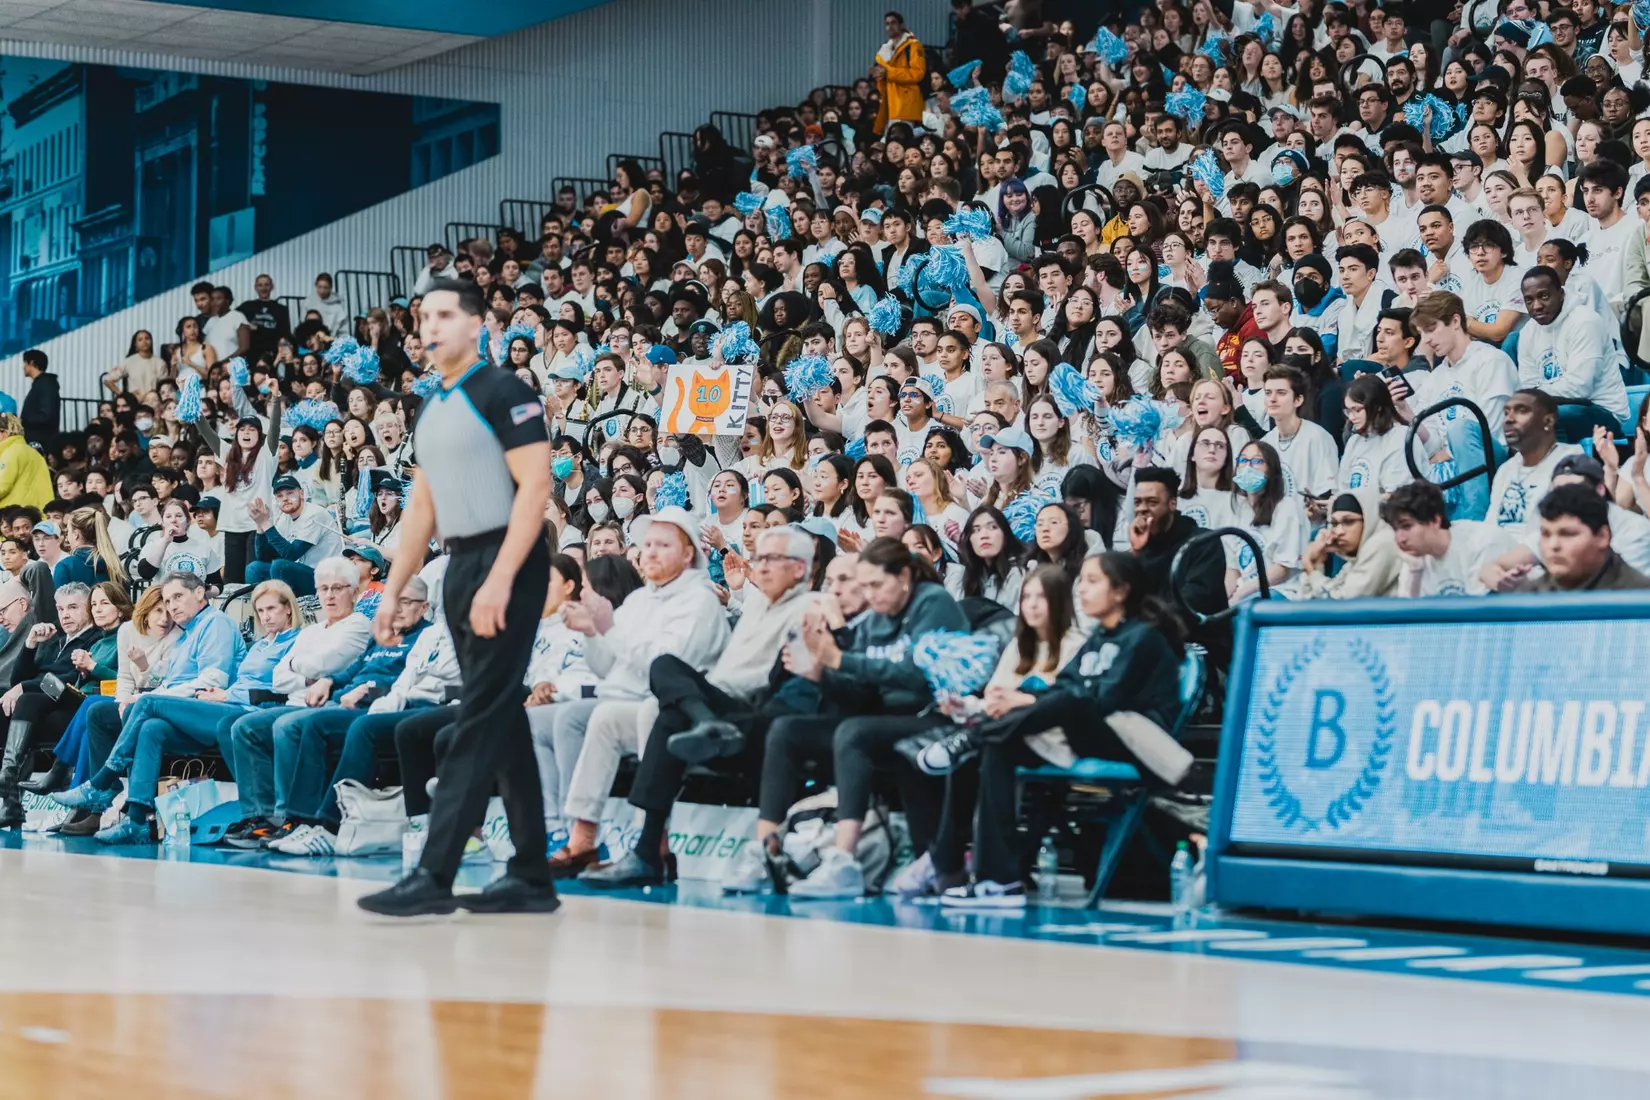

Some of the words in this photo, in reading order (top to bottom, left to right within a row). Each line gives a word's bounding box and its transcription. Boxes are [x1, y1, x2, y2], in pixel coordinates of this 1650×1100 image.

[696, 385, 722, 402] 10
[727, 368, 751, 428] KITTY
[1305, 688, 1347, 769] B
